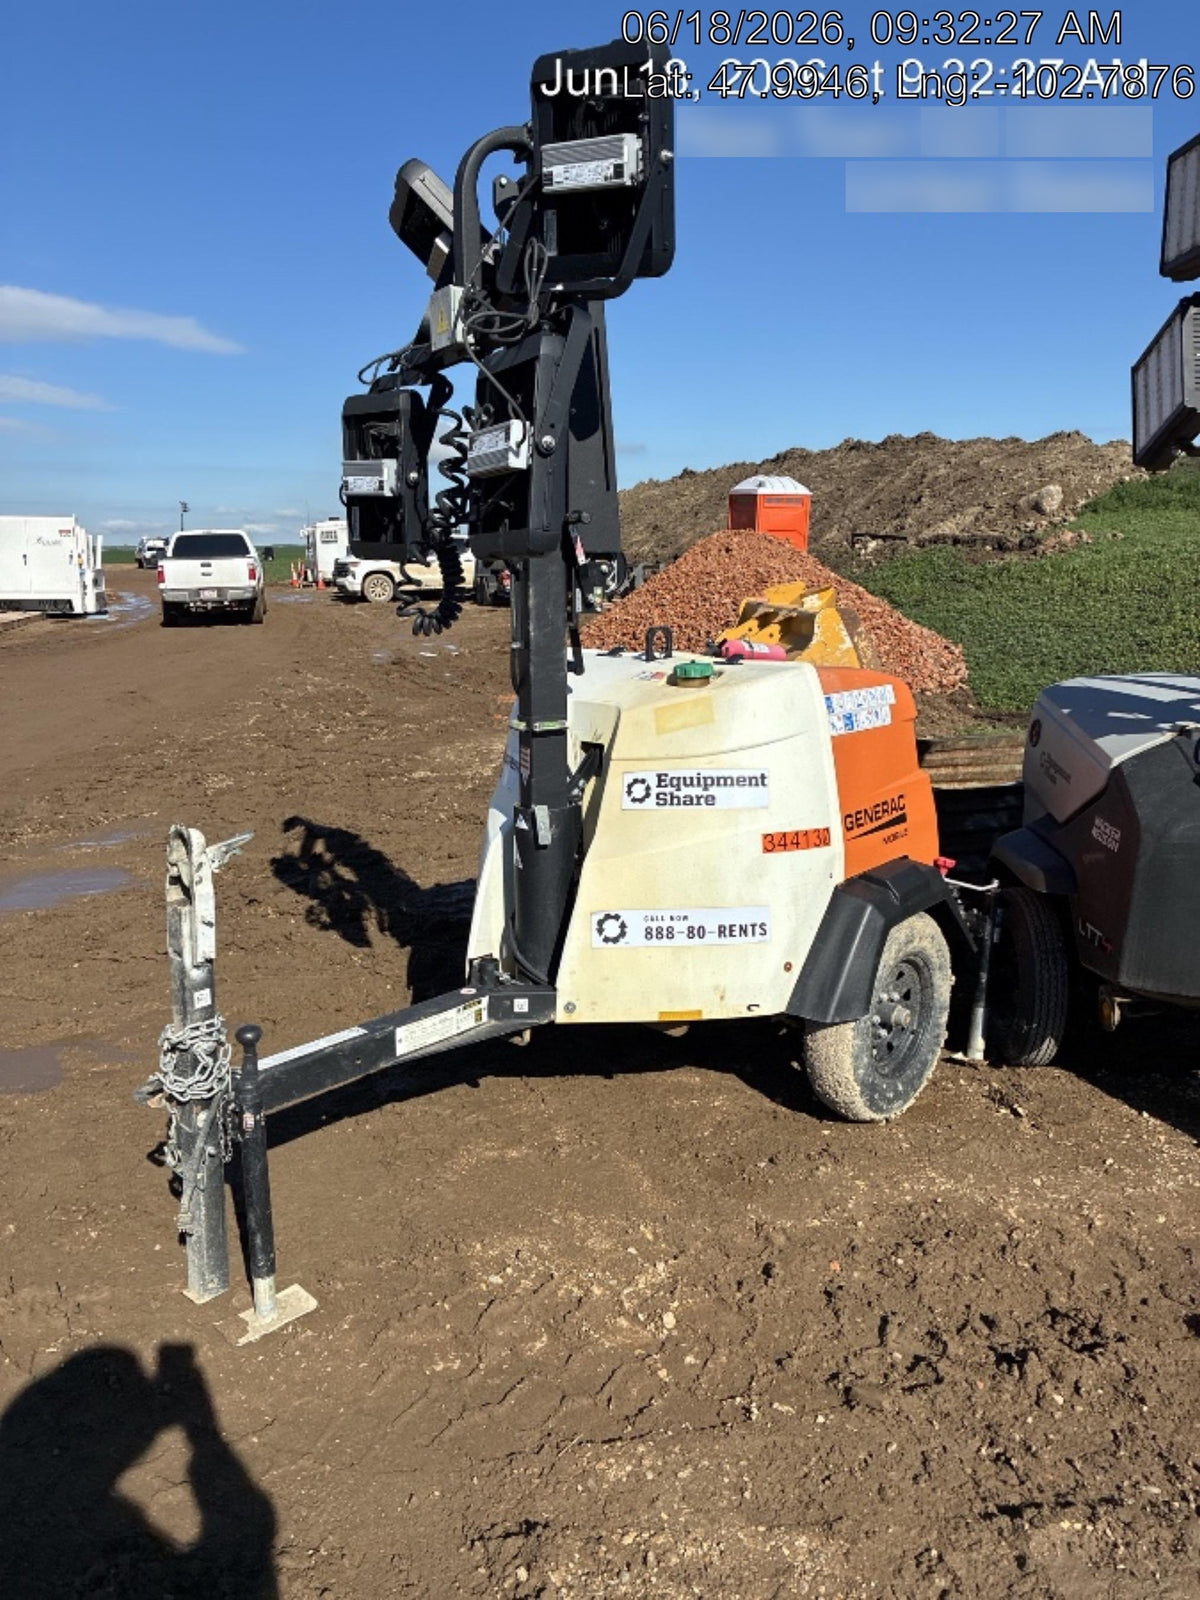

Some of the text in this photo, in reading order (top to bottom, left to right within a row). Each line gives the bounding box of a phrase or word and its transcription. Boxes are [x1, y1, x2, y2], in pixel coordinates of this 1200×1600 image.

[655, 772, 768, 792] Equipment
[655, 792, 716, 807] Share
[843, 794, 906, 832] GENERAC
[644, 922, 768, 941] 888-80-RENTS
